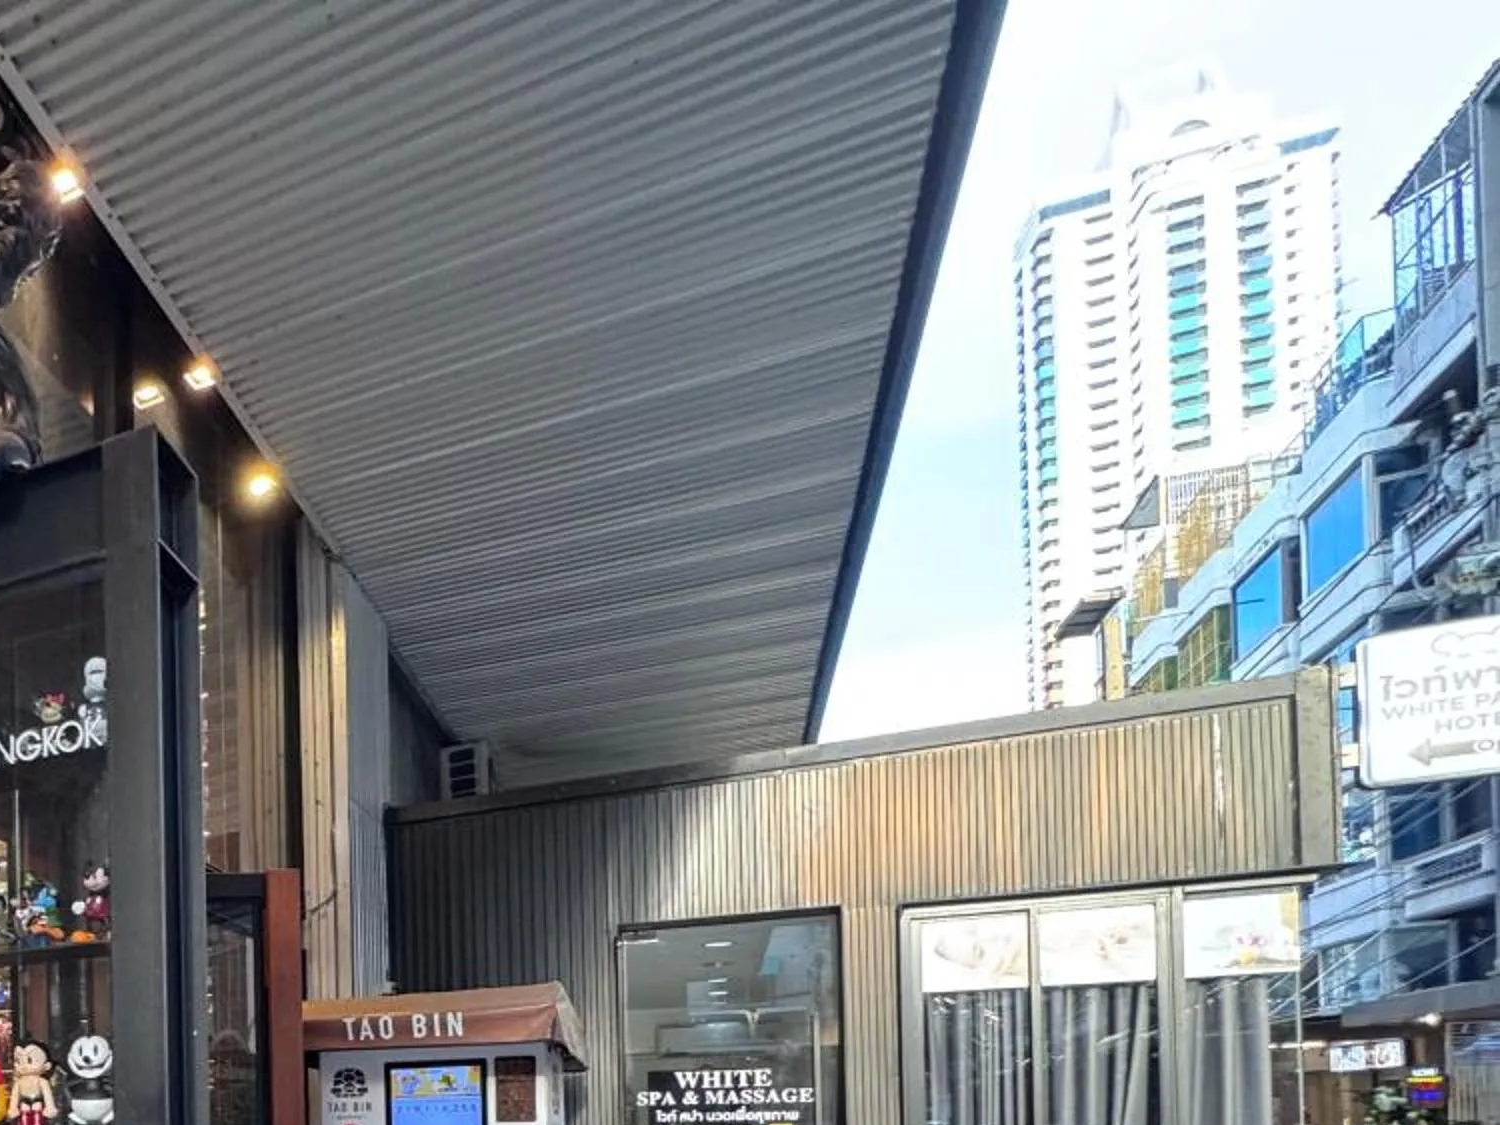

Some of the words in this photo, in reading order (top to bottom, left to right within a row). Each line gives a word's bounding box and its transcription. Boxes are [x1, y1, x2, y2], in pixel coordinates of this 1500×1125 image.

[1381, 695, 1466, 720] WHITE
[342, 1014, 393, 1041] TAO
[412, 1011, 464, 1038] BIN
[674, 1067, 773, 1090] WHITE
[635, 1090, 676, 1107] SPA
[681, 1089, 699, 1106] &
[705, 1087, 815, 1106] MASSAGE
